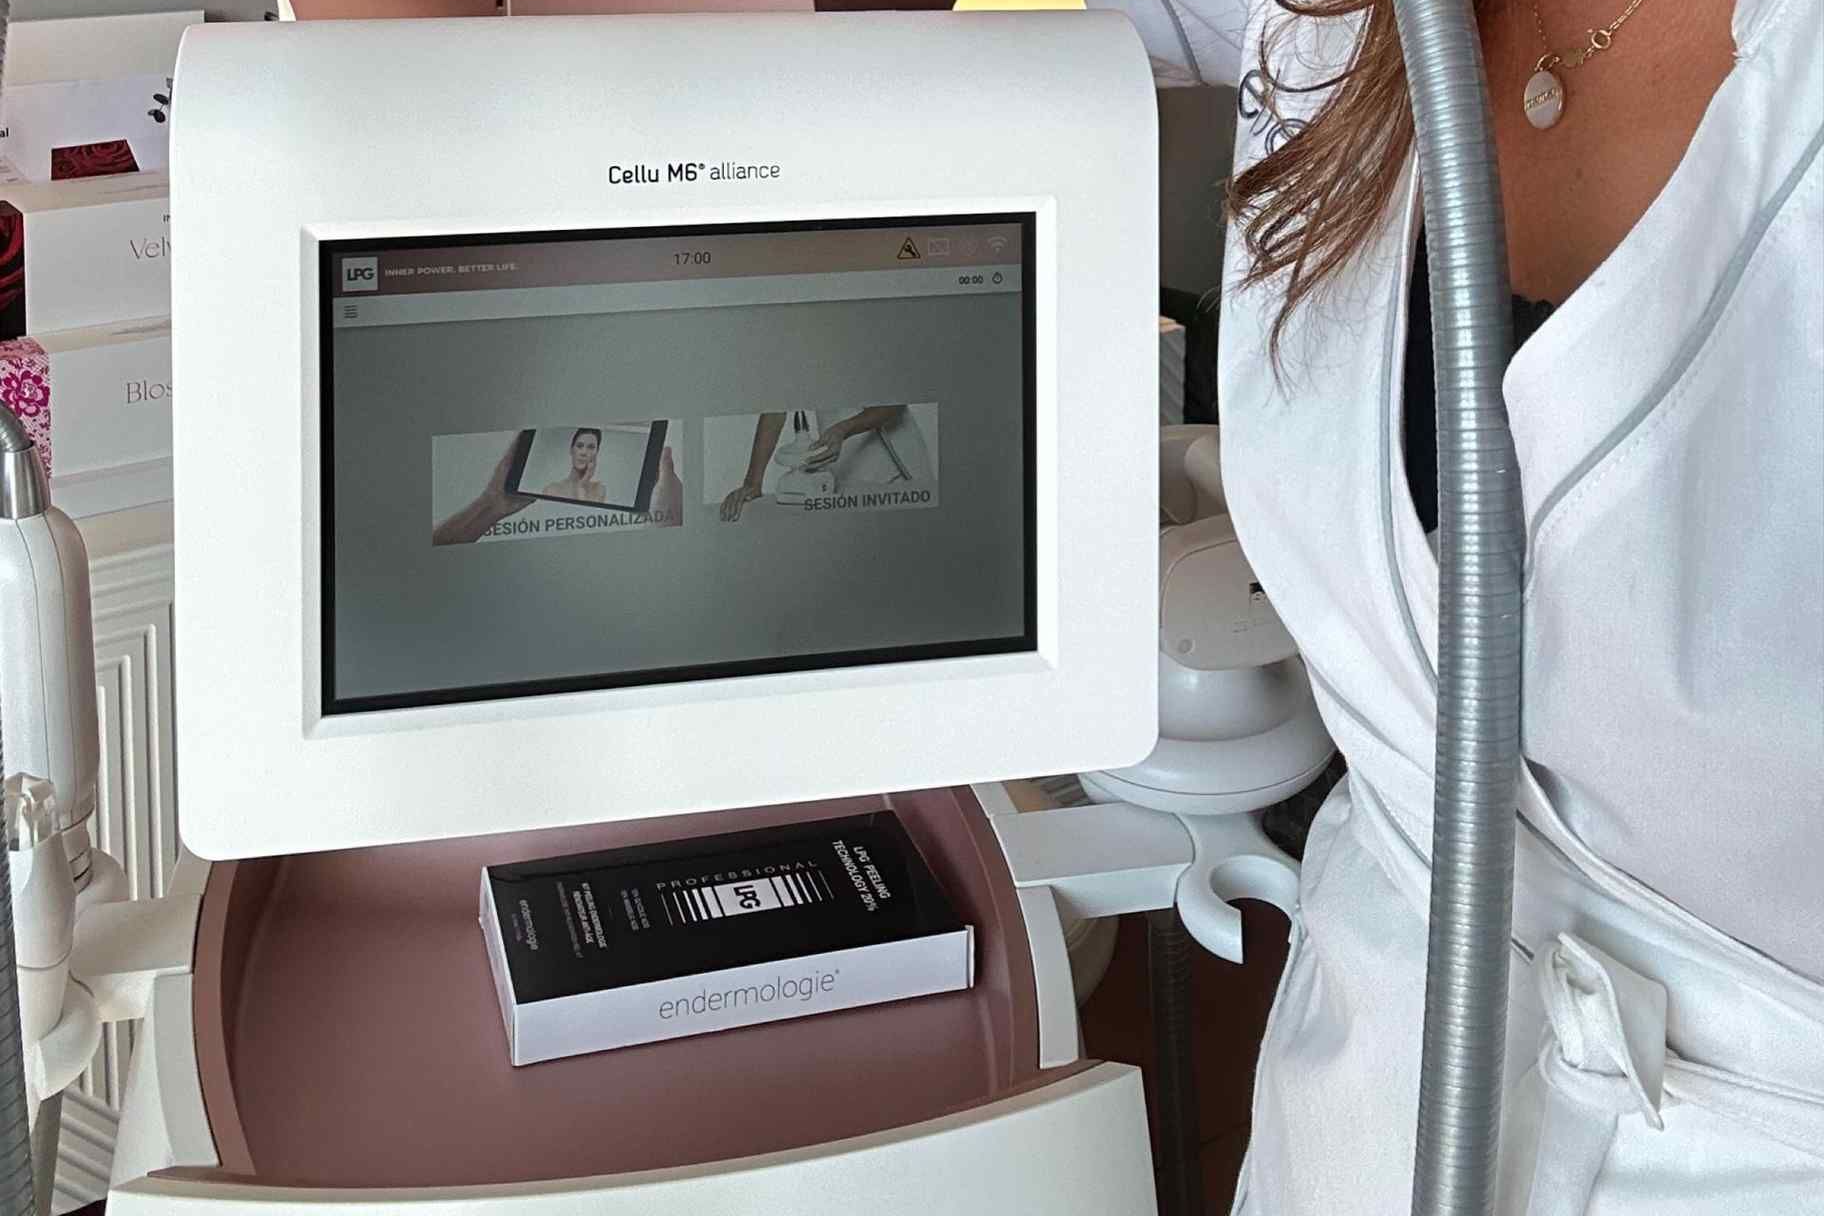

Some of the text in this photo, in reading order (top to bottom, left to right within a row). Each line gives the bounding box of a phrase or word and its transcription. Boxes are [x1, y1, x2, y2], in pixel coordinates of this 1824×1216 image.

[608, 164, 660, 184] Cellu
[709, 162, 781, 180] alliance
[674, 251, 712, 265] 17:00
[347, 267, 374, 281] LPG
[804, 487, 931, 511] SESIÓN INVITADO
[545, 509, 674, 532] PERSONALIZADA
[656, 860, 818, 890] PROFESSIONAL
[832, 840, 870, 892] TECHNOLOGY
[853, 846, 891, 898] LPG PEELING
[733, 885, 761, 909] LPG
